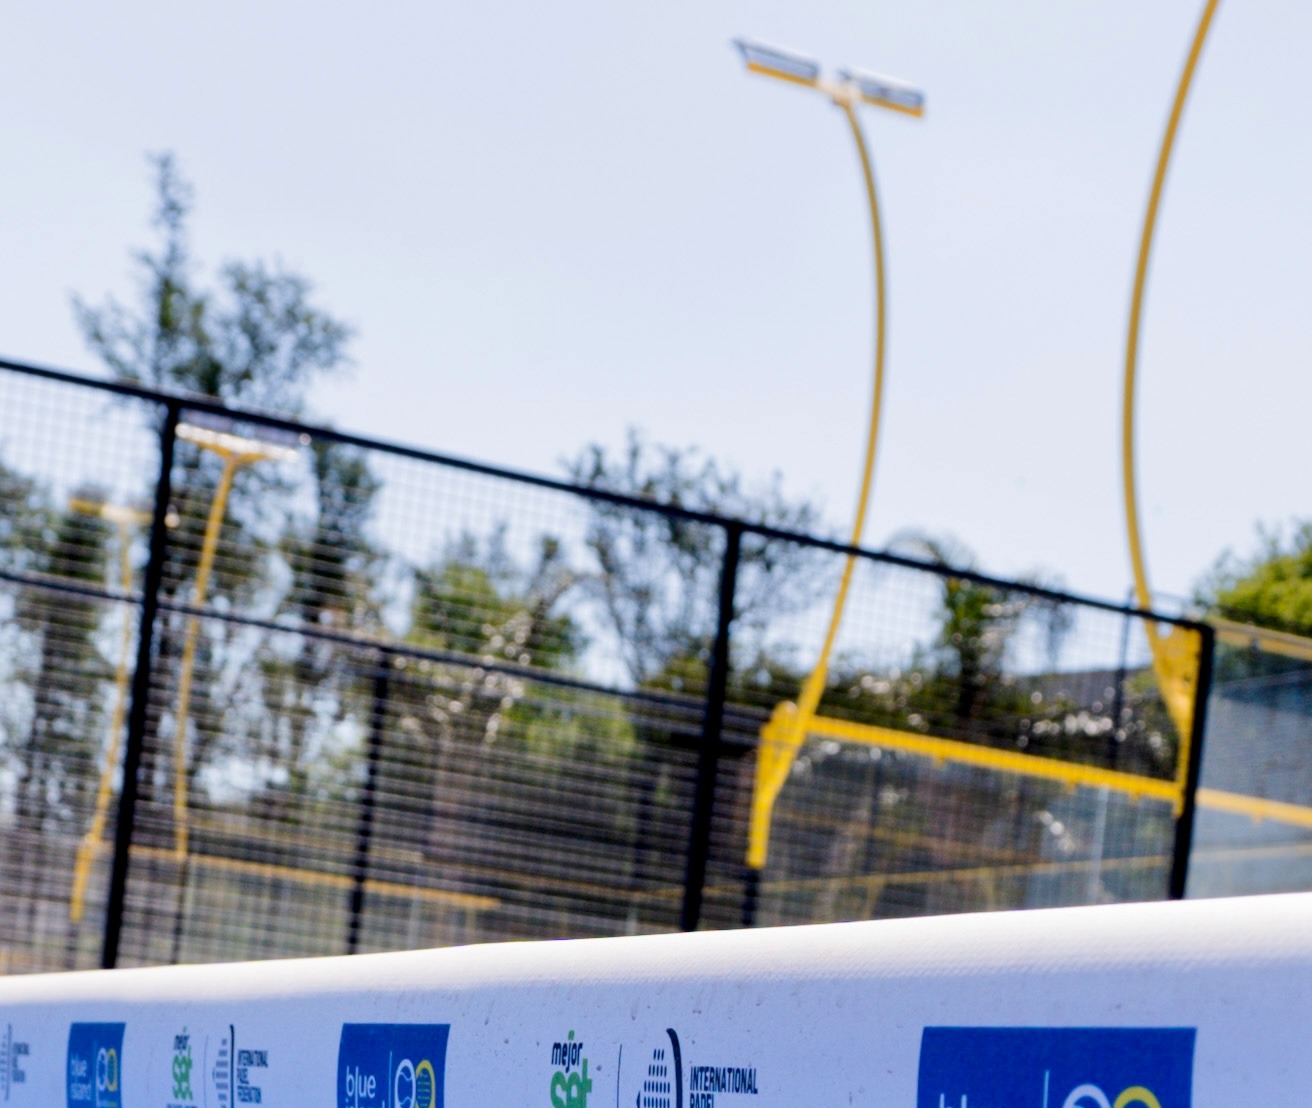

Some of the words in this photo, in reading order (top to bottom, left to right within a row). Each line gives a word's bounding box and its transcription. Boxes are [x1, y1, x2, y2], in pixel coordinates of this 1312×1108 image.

[551, 1030, 583, 1073] mejor
[346, 1065, 376, 1099] blue
[690, 1065, 758, 1095] INTERNATIONAL
